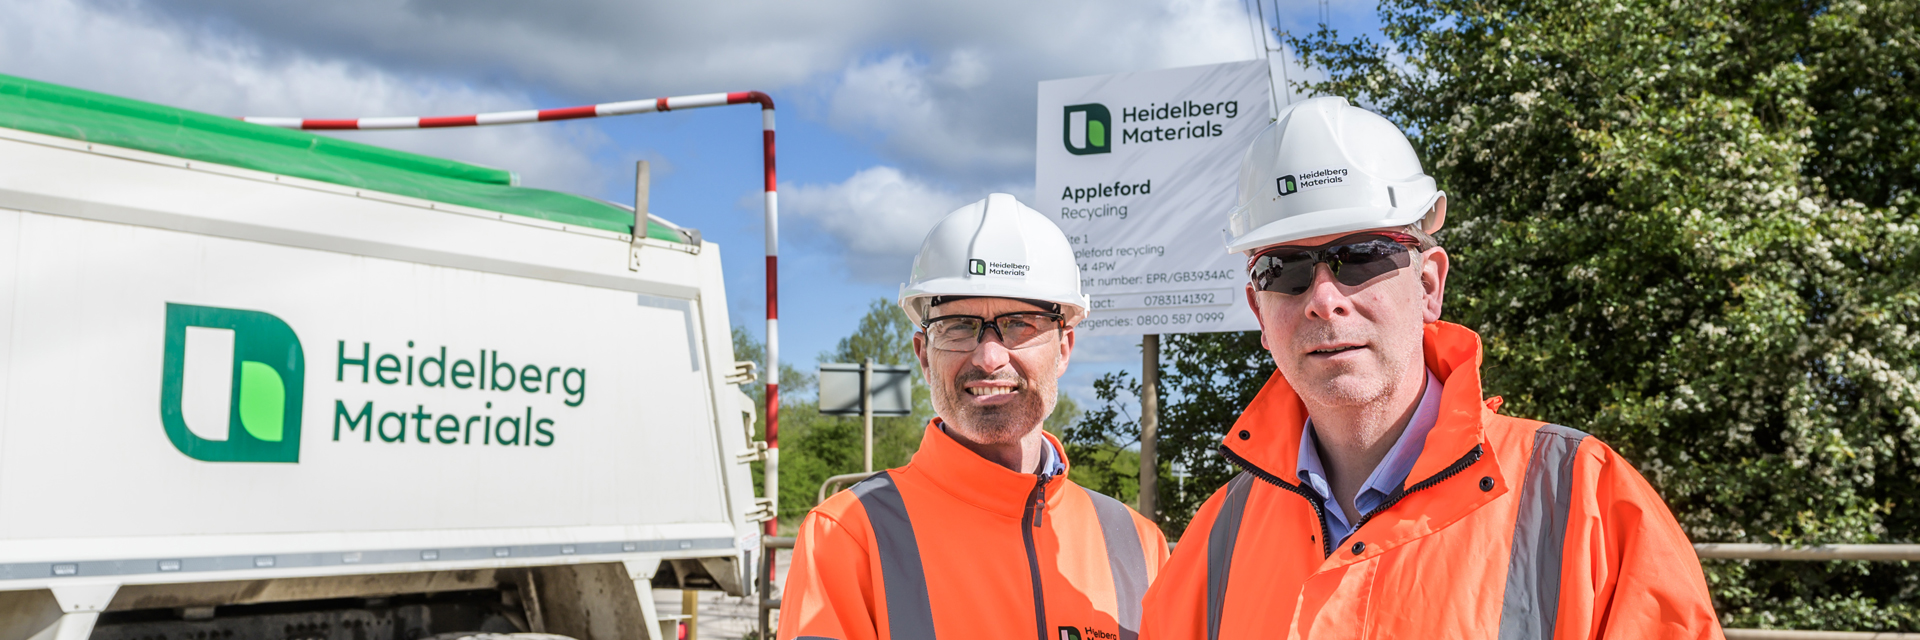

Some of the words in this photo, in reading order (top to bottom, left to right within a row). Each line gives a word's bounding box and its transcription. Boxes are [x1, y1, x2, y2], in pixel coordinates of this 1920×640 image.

[1122, 100, 1238, 123] Heidelberg
[1122, 120, 1223, 144] Materials
[1299, 168, 1348, 181] Heidelberg
[1300, 175, 1343, 188] Materials
[1061, 179, 1151, 203] Appleford
[1061, 204, 1128, 221] Recycling
[1066, 234, 1081, 244] ite
[1083, 234, 1089, 244] 1
[1074, 246, 1113, 261] pleford
[1116, 244, 1165, 258] recycling
[989, 261, 1030, 271] Heidelberg
[989, 268, 1025, 276] Materials
[1091, 261, 1116, 271] 4PW
[1080, 276, 1095, 287] mit
[1097, 275, 1143, 287] number:
[1146, 268, 1235, 284] EPR/GB3934AC
[1090, 298, 1115, 309] tact:
[1143, 292, 1215, 307] 07831141392
[1076, 315, 1134, 331] ergencies:
[1136, 314, 1169, 326] 0800
[1172, 313, 1192, 325] 587
[1195, 311, 1225, 324] 0999
[336, 340, 586, 407] Heidelberg
[332, 399, 555, 447] Materials
